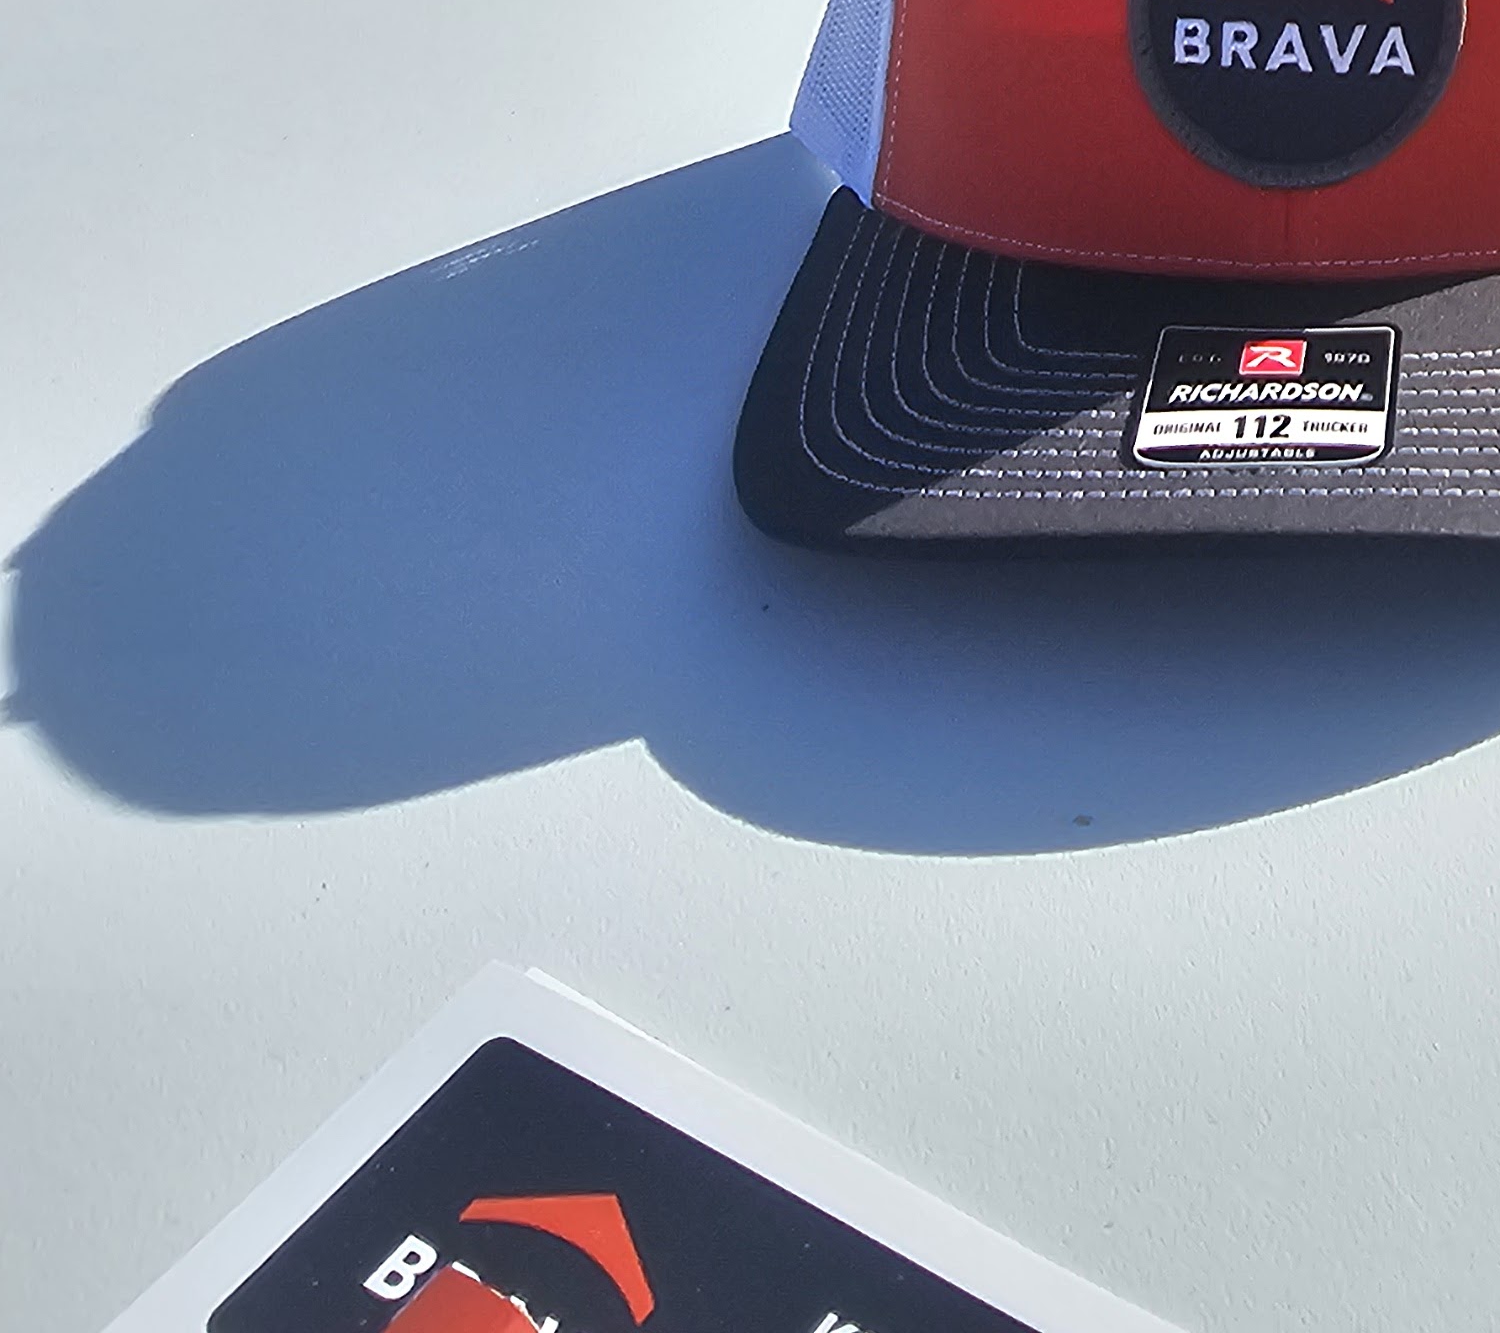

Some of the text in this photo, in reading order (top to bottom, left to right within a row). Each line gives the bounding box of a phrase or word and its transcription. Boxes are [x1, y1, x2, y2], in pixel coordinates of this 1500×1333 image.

[1174, 17, 1415, 75] BRAVA
[1168, 383, 1364, 404] RICHARDSON
[1153, 414, 1369, 439] ORIGINAL 112 TRUCKER
[1199, 447, 1317, 460] ADJUSTABLE
